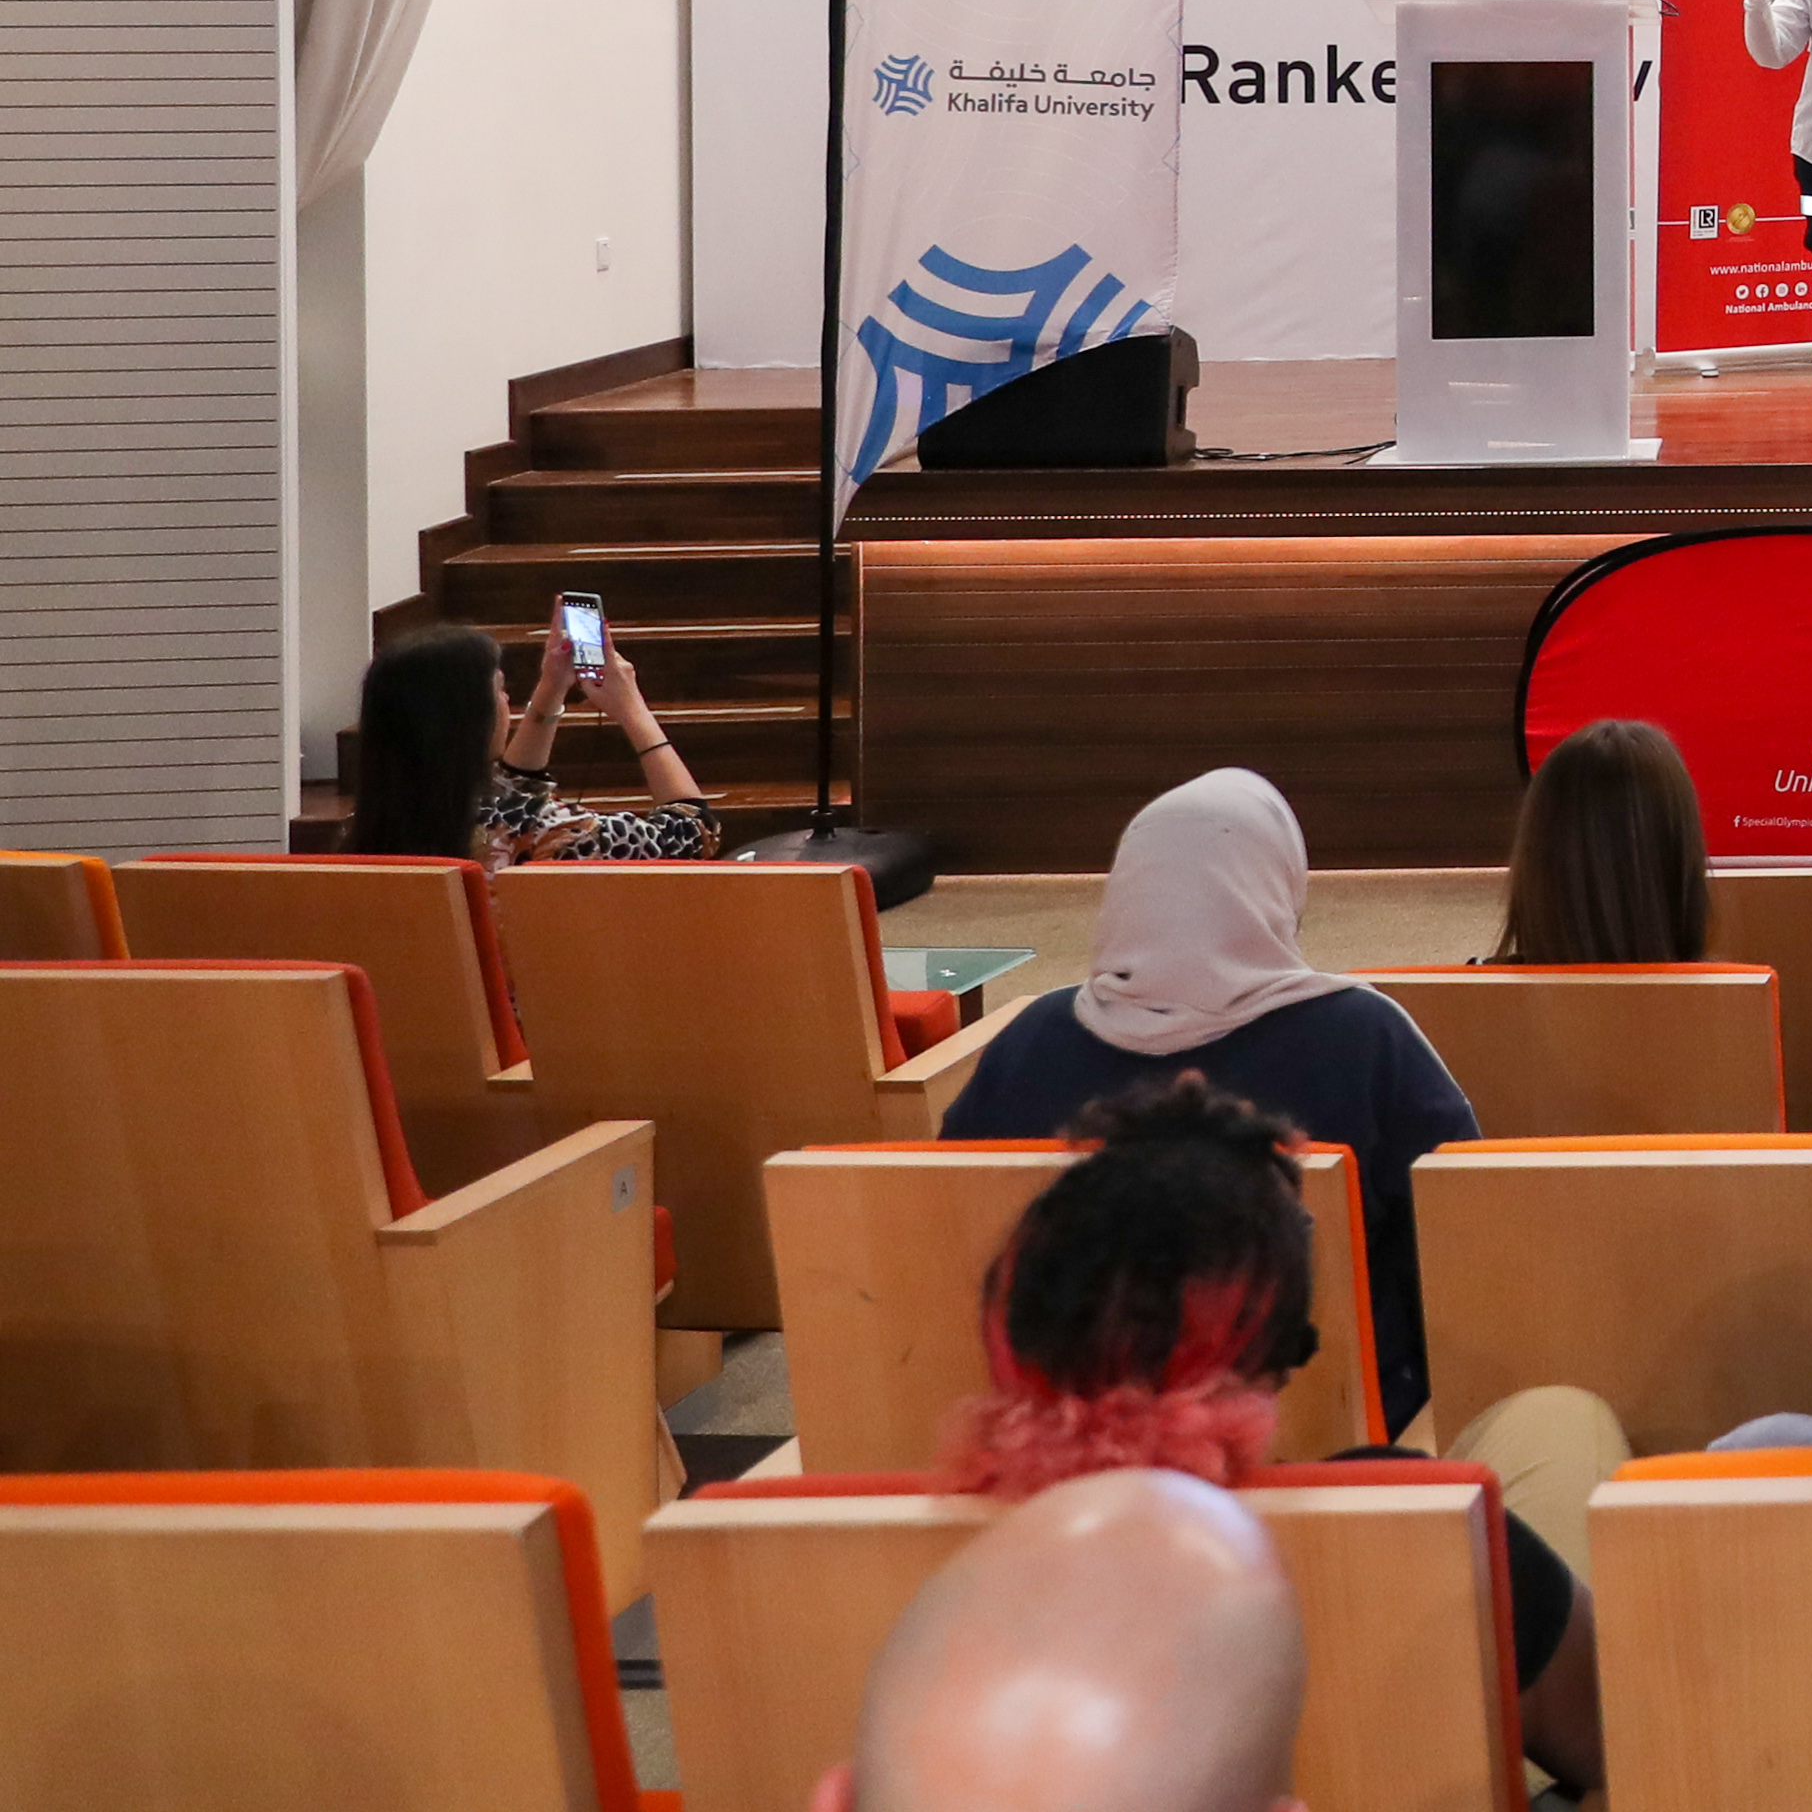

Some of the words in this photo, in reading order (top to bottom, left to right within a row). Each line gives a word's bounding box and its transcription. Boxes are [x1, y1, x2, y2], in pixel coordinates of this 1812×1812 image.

[949, 60, 1047, 88] خليفة
[1053, 64, 1156, 92] جامعة
[947, 92, 1028, 114] Khalifa
[1034, 94, 1155, 123] University
[1725, 302, 1766, 315] National
